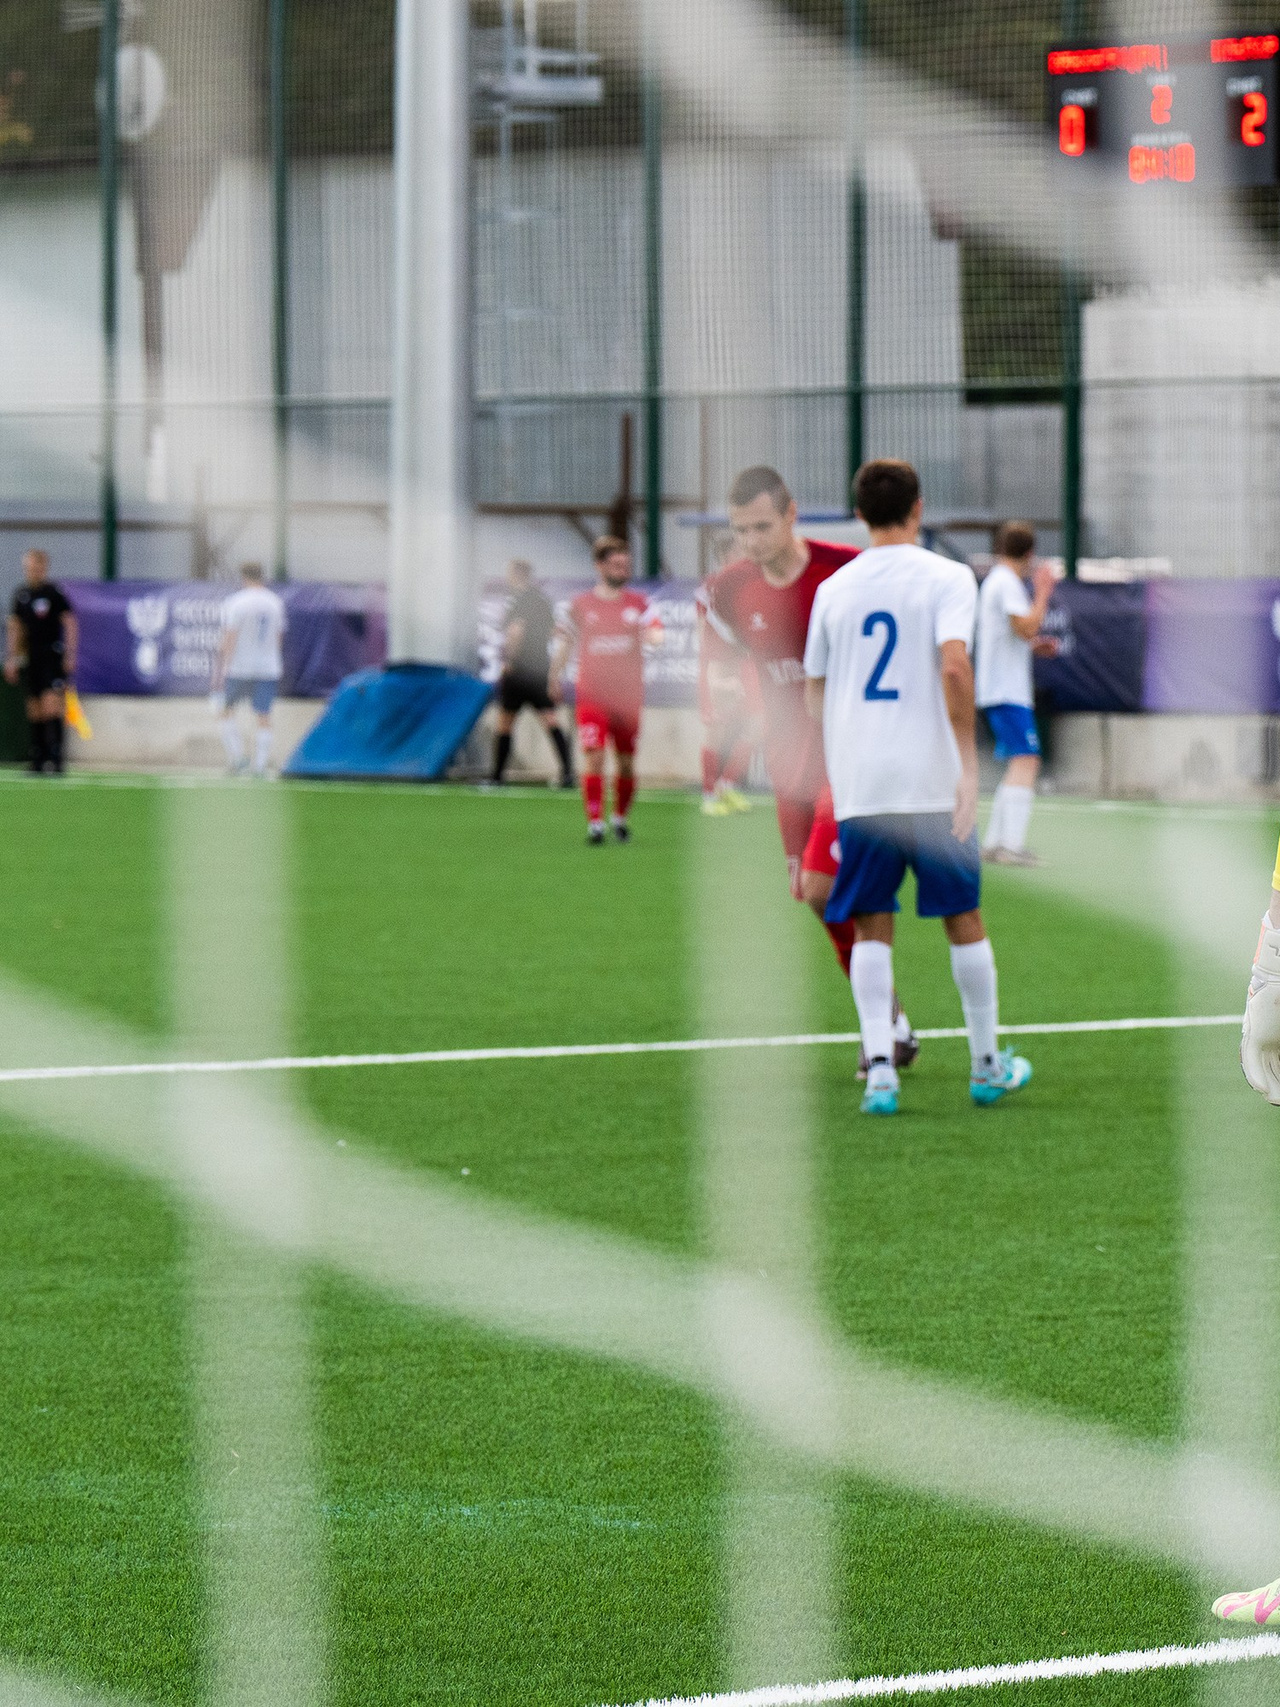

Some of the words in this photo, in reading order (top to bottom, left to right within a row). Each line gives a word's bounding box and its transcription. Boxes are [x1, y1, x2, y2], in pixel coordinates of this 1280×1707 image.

[1059, 104, 1086, 157] 0
[1151, 84, 1173, 124] 2
[1241, 92, 1268, 147] 2
[862, 611, 899, 700] 2
